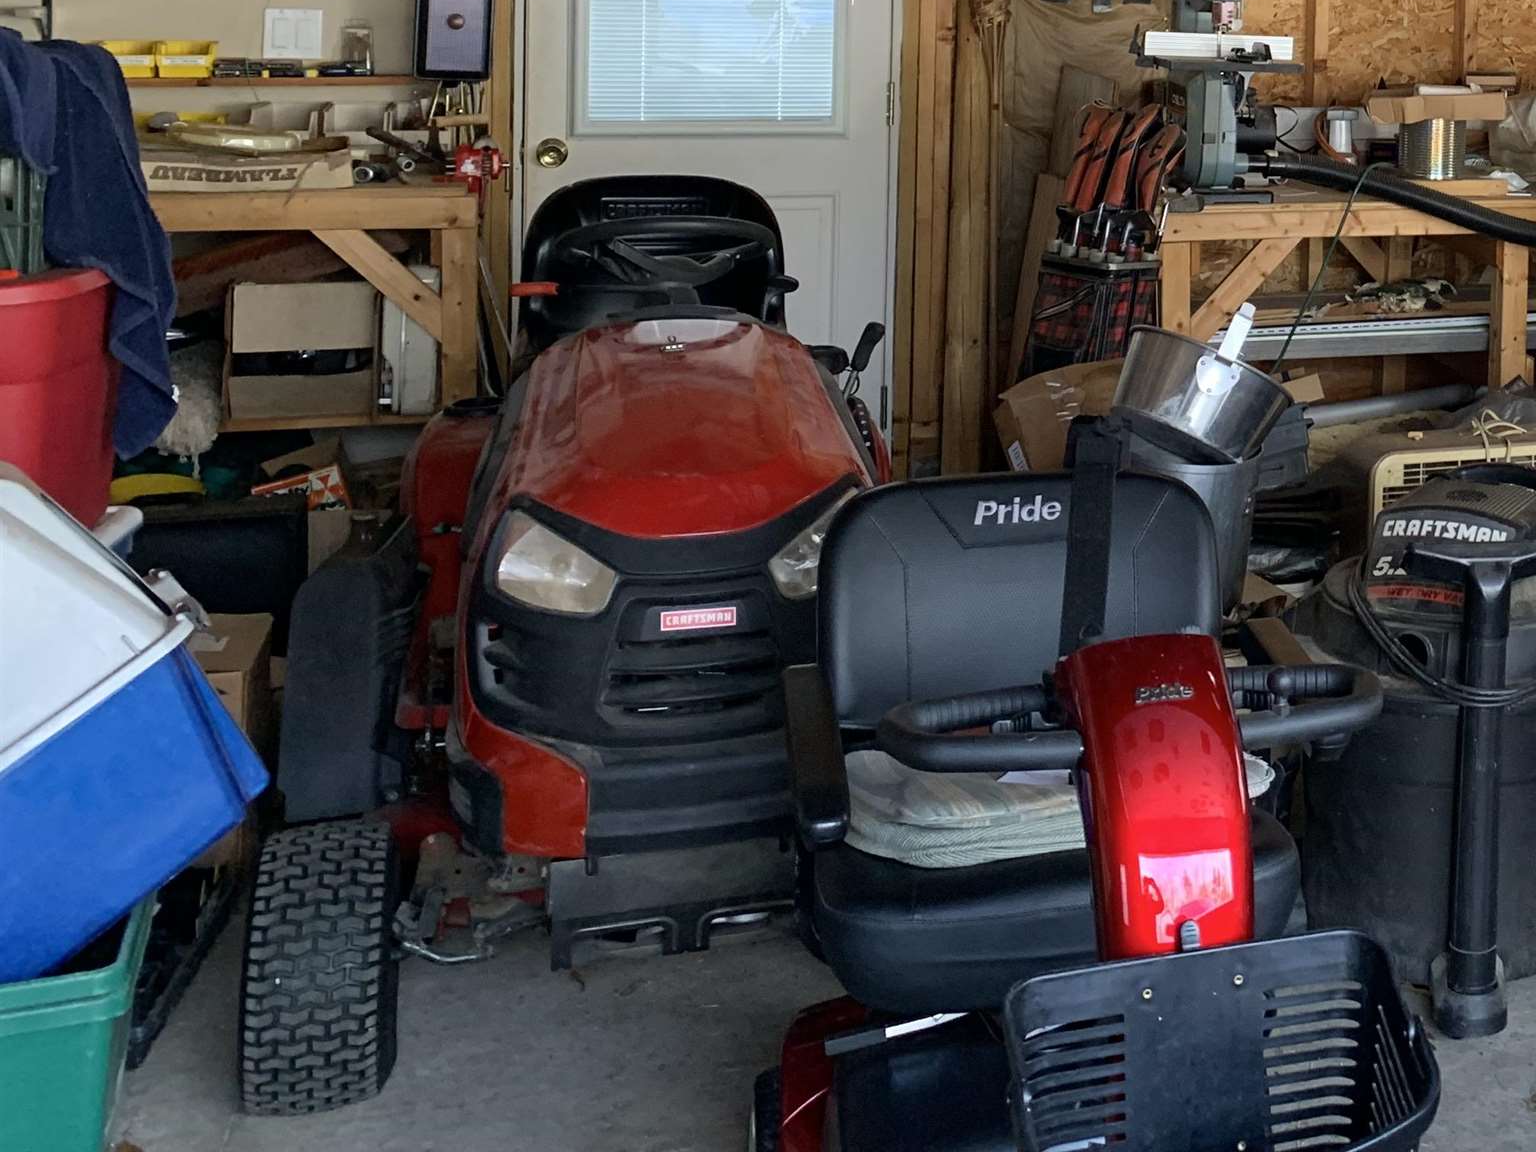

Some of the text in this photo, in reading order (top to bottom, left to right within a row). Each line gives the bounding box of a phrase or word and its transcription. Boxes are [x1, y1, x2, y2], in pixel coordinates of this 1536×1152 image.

[149, 165, 299, 184] FLAMBEAU
[974, 495, 1062, 525] Pride
[1382, 519, 1507, 542] CRAFTSMAN
[665, 612, 731, 626] CRAFTSMAN
